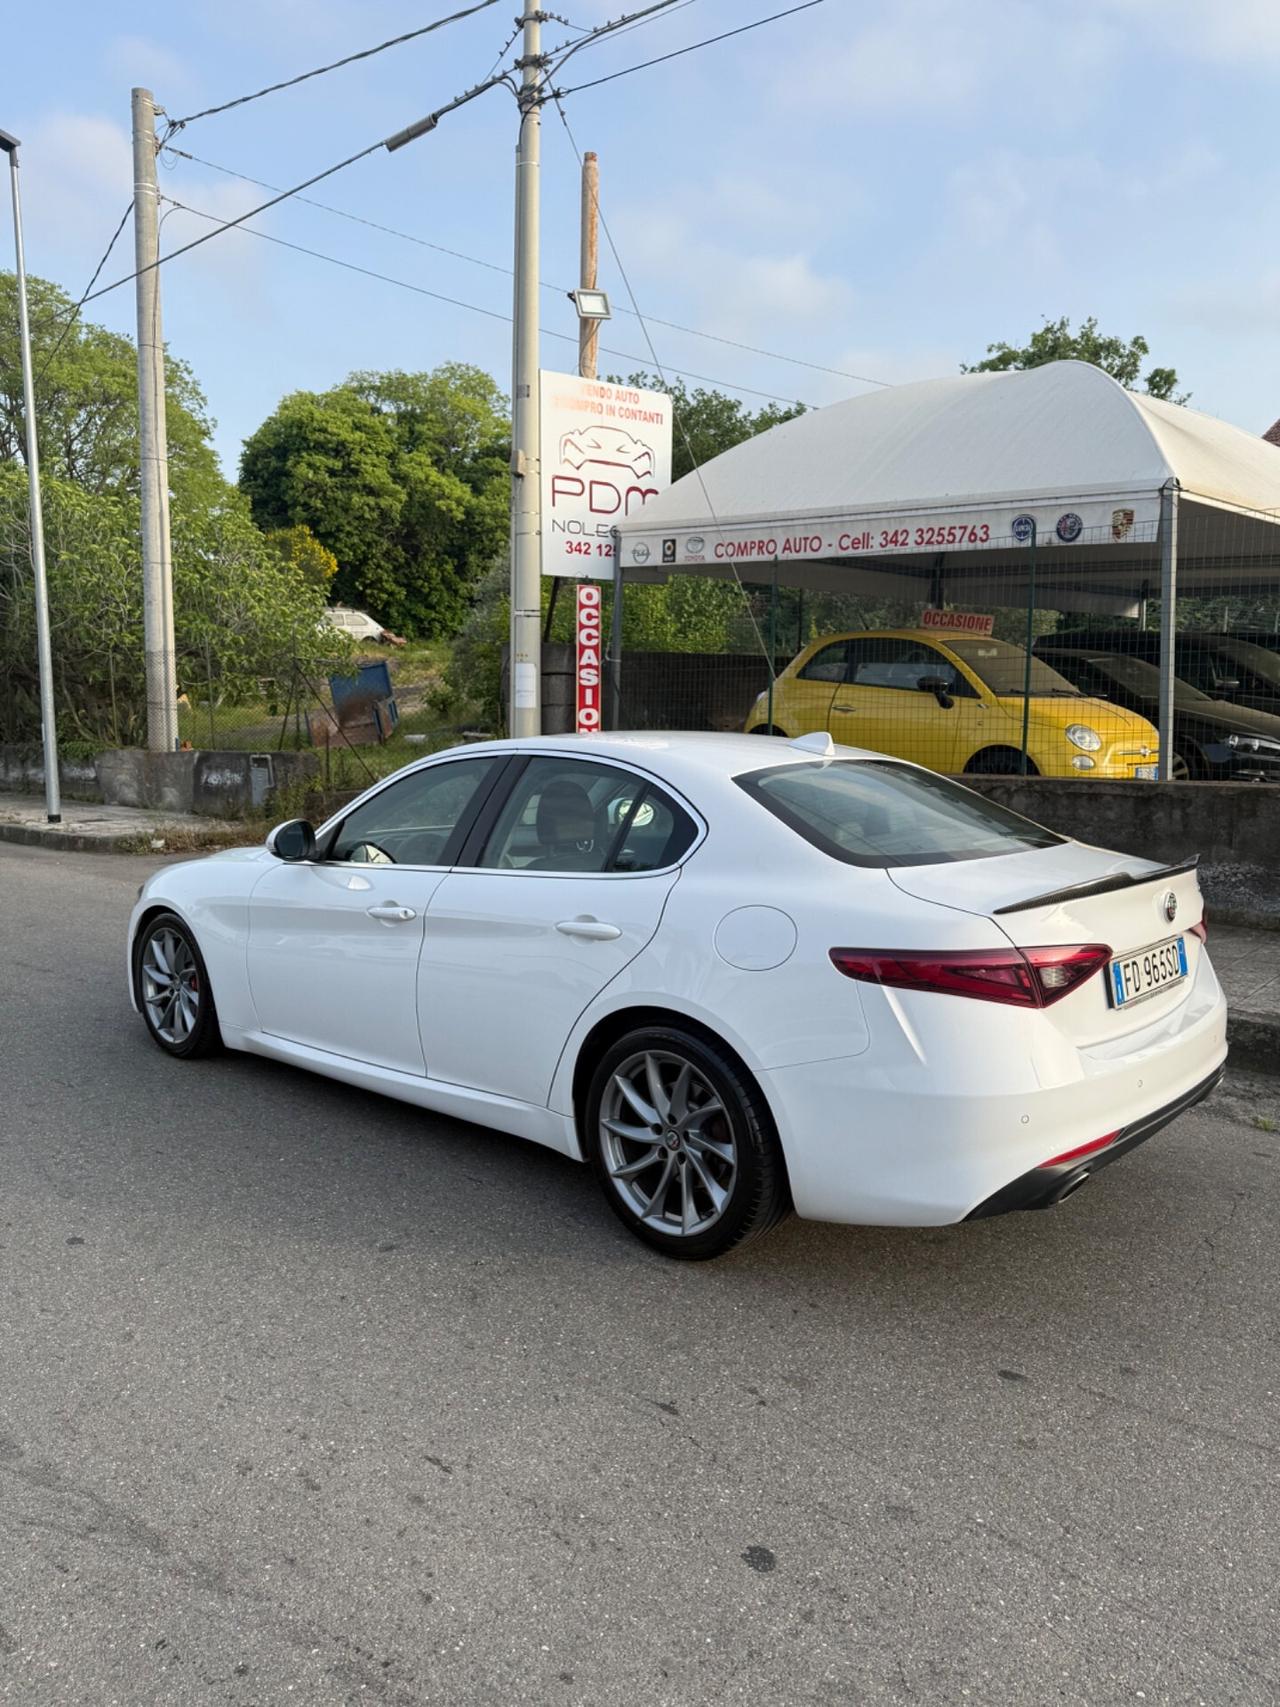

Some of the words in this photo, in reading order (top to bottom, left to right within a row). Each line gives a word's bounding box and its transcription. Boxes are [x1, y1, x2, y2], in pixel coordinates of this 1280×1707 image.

[582, 383, 613, 399] ENDO
[615, 388, 640, 404] AUTO
[606, 404, 616, 417] IN
[618, 406, 664, 425] CONTANTI
[565, 540, 592, 556] 342
[714, 538, 777, 559] COMPRO
[781, 535, 822, 554] AUTO
[838, 532, 875, 551] Cell:
[879, 529, 909, 548] 342
[914, 524, 990, 546] 3255763
[923, 611, 993, 631] OCCASIONE
[1123, 959, 1141, 997] FD
[1143, 945, 1180, 987] 965SD
